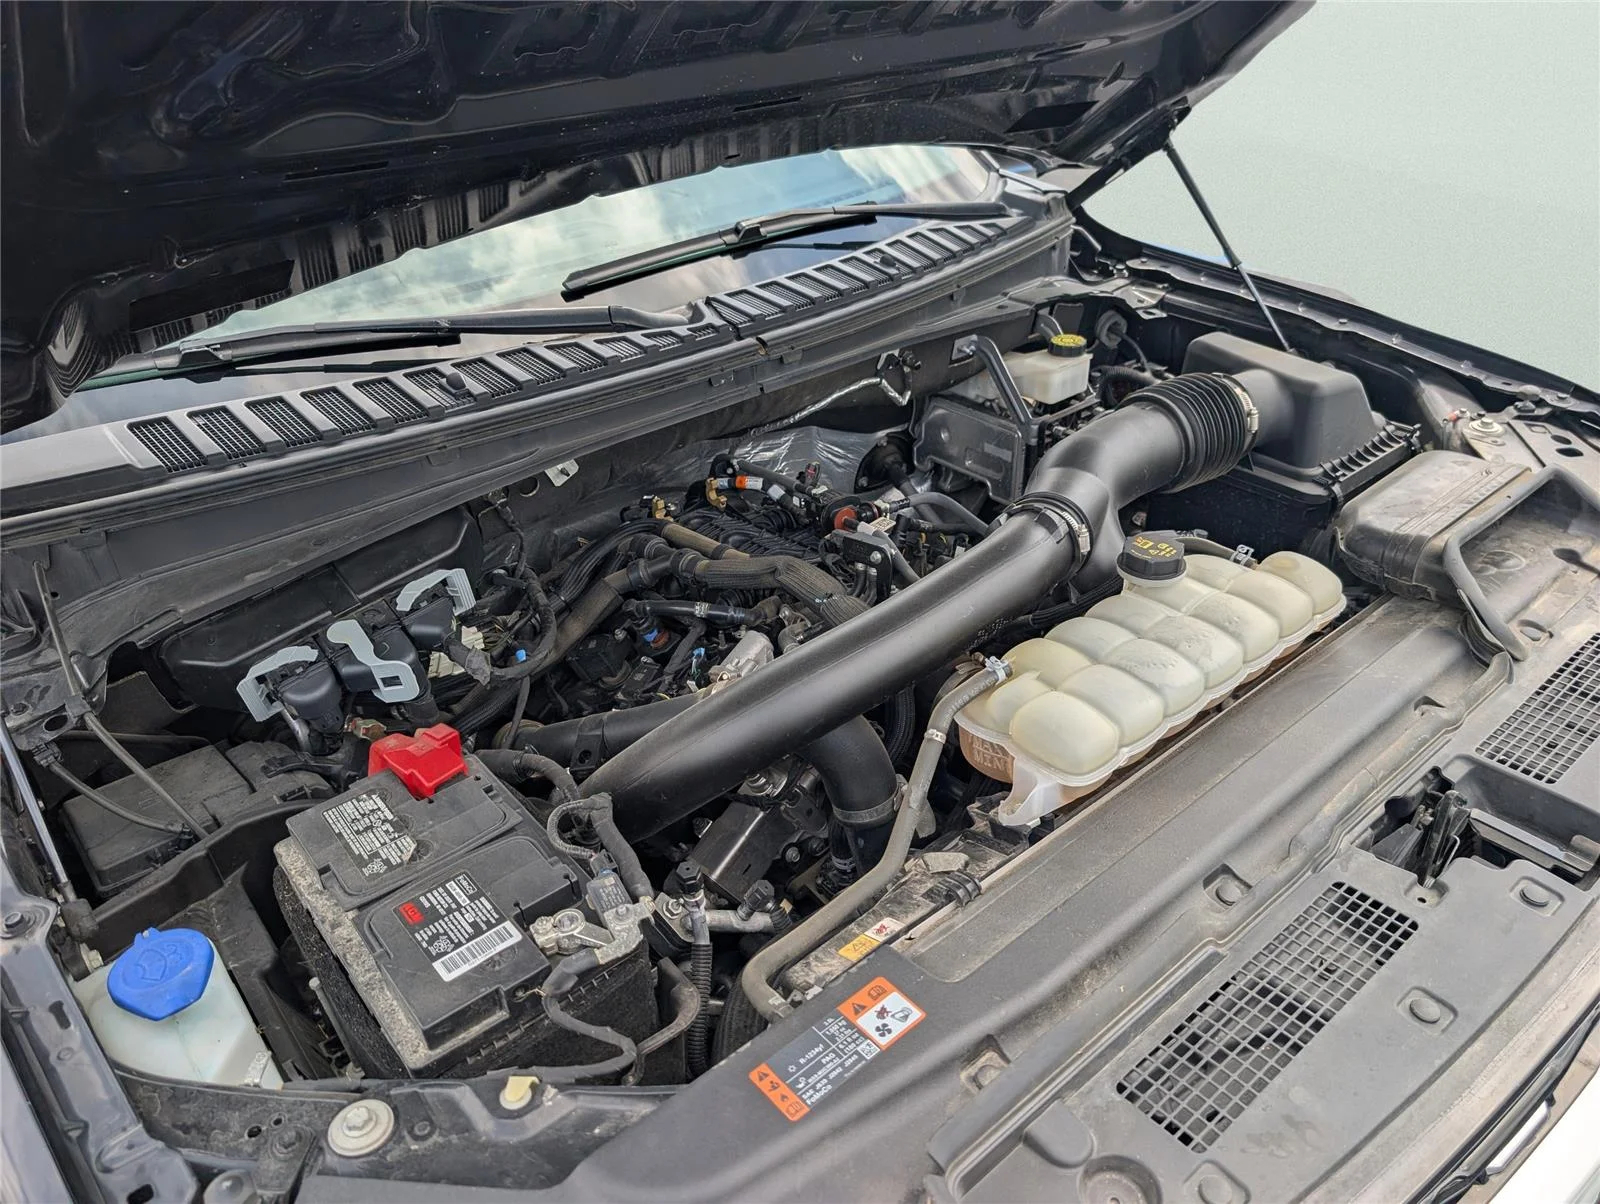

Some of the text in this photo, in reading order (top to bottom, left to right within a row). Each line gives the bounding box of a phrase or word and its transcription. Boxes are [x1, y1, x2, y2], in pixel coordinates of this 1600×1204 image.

[973, 749, 1005, 770] MIN
[798, 1043, 826, 1065] R-1234yf
[801, 1088, 814, 1099] SAE
[805, 1082, 832, 1105] FoMoCo
